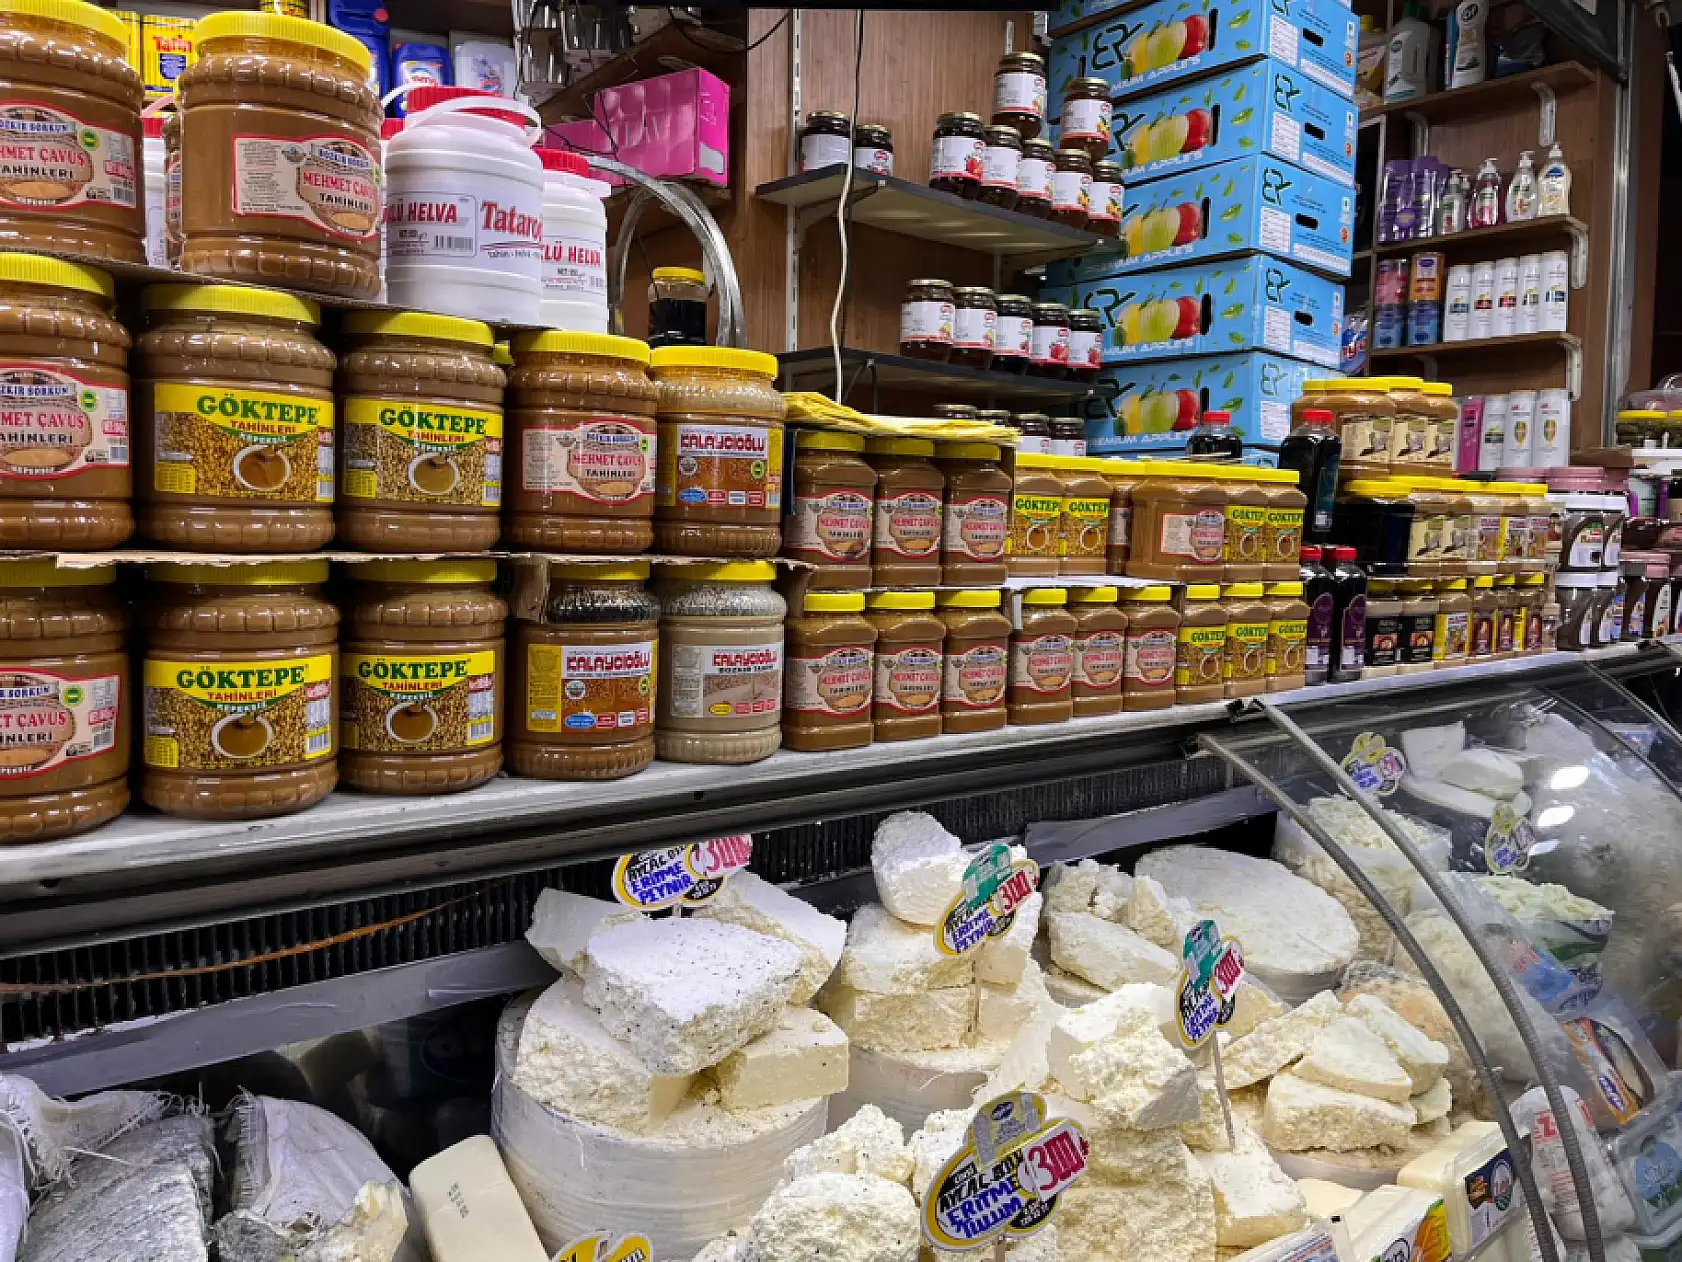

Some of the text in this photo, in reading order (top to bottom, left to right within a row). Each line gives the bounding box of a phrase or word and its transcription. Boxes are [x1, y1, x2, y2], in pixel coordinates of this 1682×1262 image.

[0, 164, 74, 181] AHİNLERİ
[407, 201, 457, 224] HELVA
[196, 393, 319, 426] GÖKTEPE
[379, 405, 486, 435] GÖKTEPE
[0, 429, 74, 445] AHİNLERİ
[176, 664, 305, 689] GÖKTEPE
[358, 658, 467, 680] GÖKTEPE
[1028, 1130, 1085, 1192] 300
